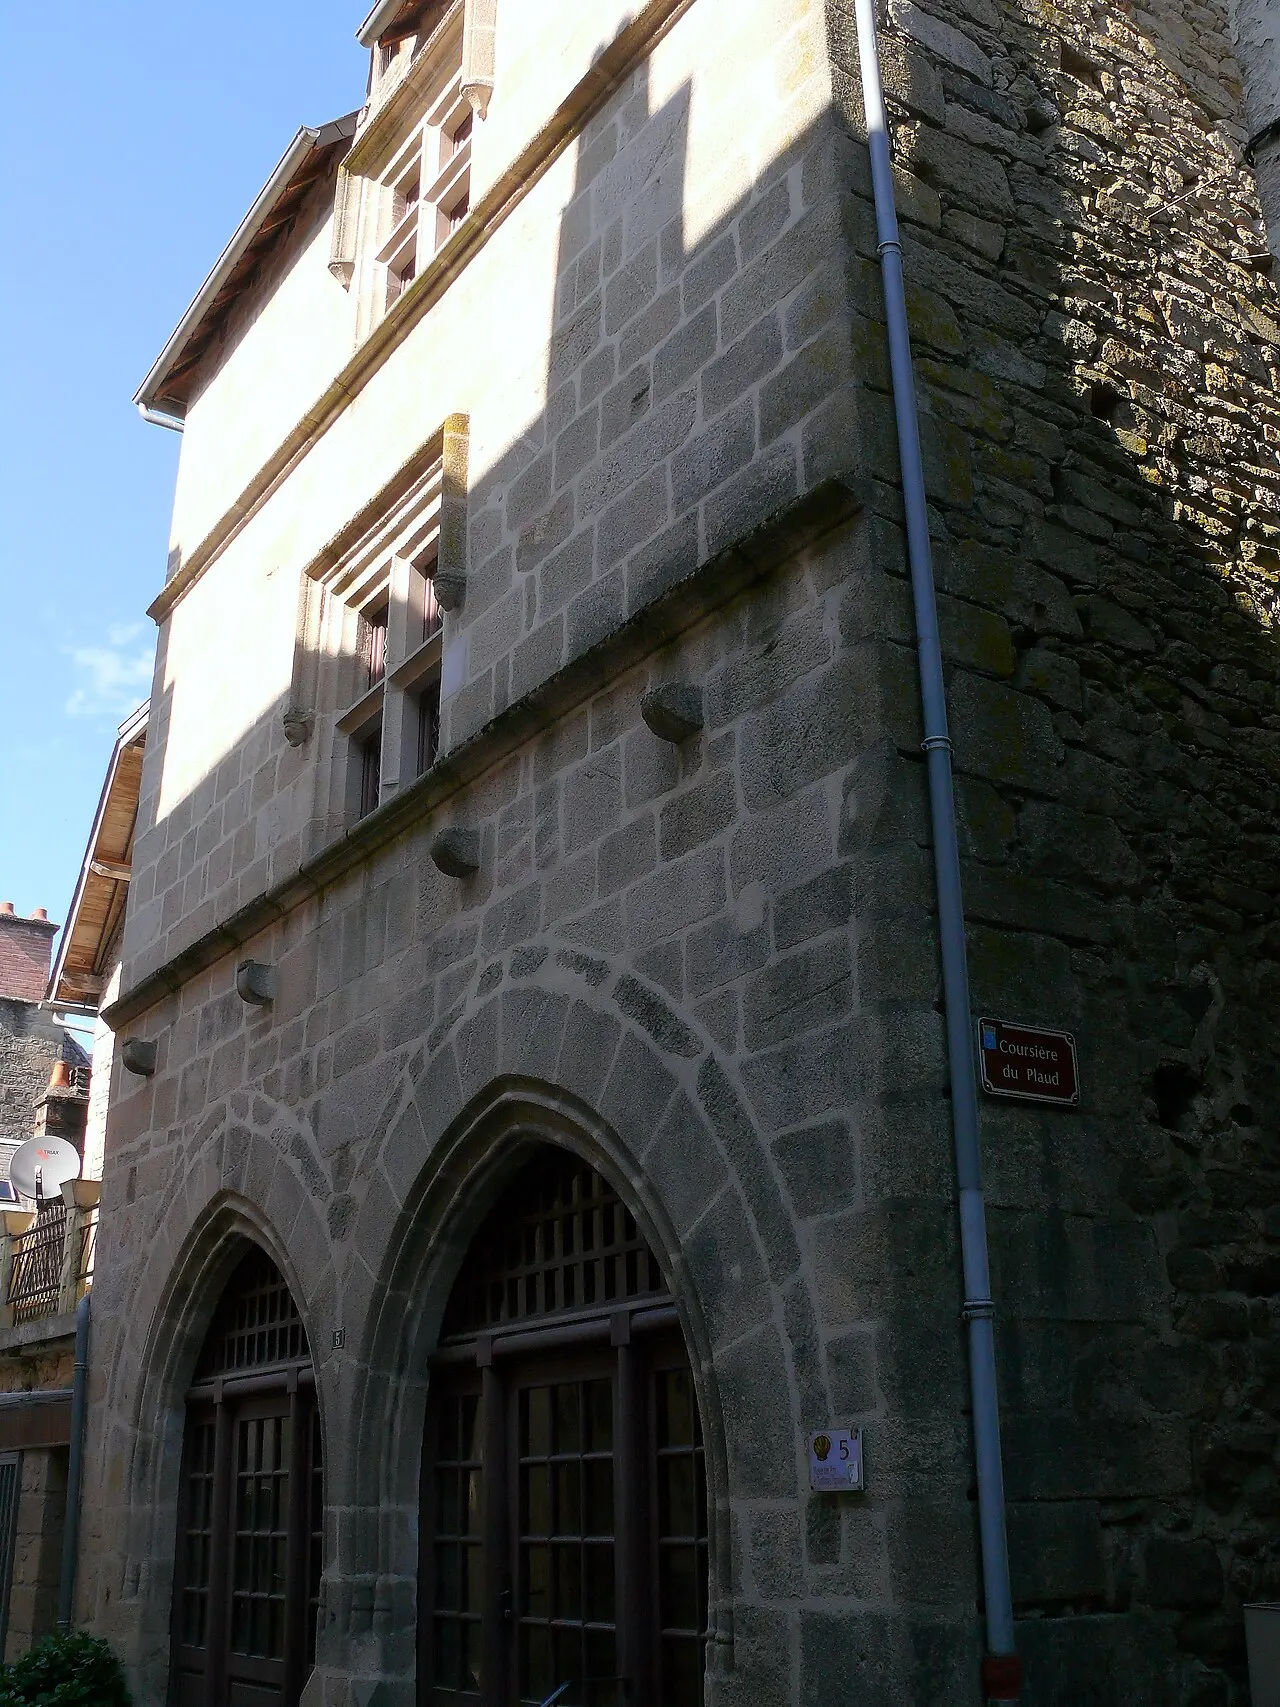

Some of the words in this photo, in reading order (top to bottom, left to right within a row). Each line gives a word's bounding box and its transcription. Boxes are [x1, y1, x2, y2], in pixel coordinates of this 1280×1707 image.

[999, 1039, 1058, 1061] Coursière
[1002, 1064, 1019, 1080] du
[1026, 1068, 1060, 1086] Plaud
[839, 1439, 850, 1461] 5
